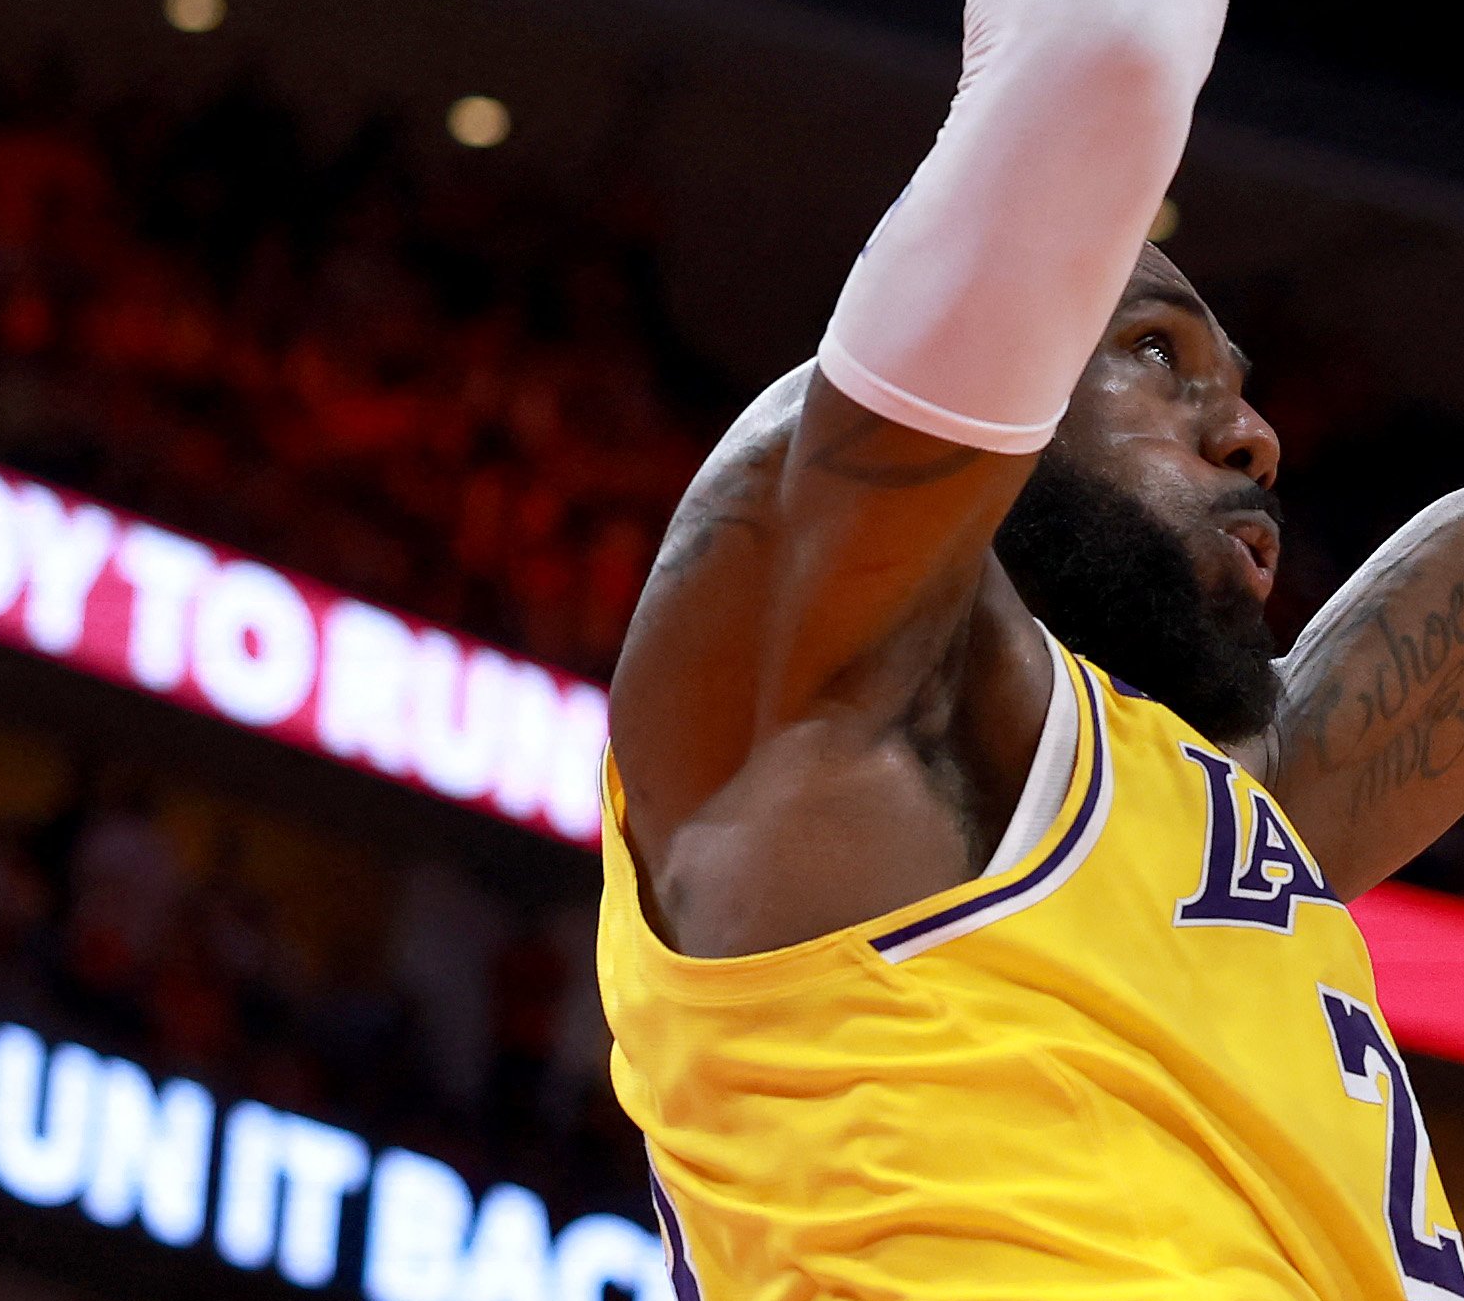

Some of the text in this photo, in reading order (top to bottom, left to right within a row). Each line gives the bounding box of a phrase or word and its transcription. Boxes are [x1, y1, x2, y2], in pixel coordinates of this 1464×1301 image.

[116, 521, 319, 727] TO
[315, 597, 611, 843] RUN
[215, 1099, 371, 1288] IT
